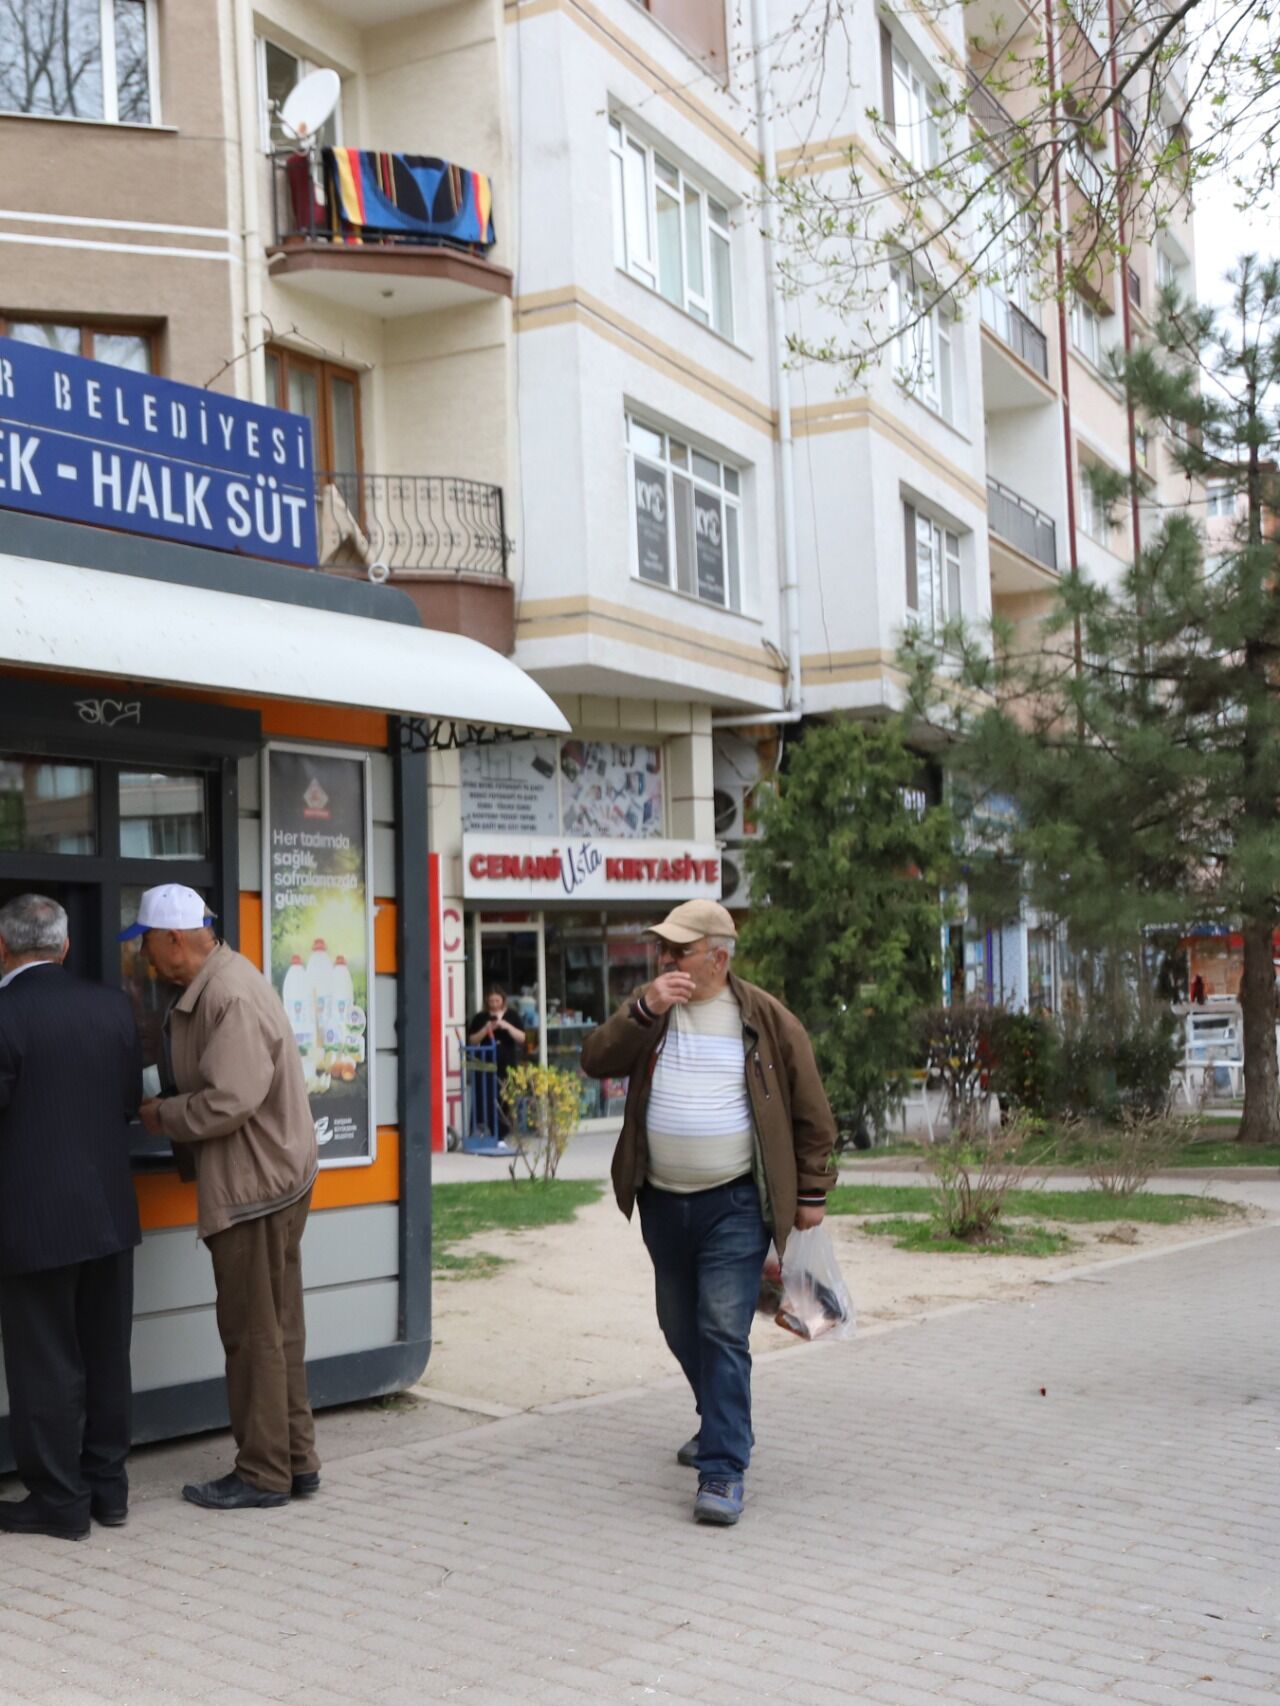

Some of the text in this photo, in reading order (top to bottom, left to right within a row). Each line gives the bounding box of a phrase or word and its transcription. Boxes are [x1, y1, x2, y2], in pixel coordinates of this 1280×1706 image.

[54, 372, 306, 470] BELEDİYESİ
[93, 450, 214, 531] HALK
[227, 474, 307, 547] SÜT
[273, 829, 298, 846] Her
[560, 841, 602, 894] Usta
[605, 852, 719, 884] KIRTASİYE
